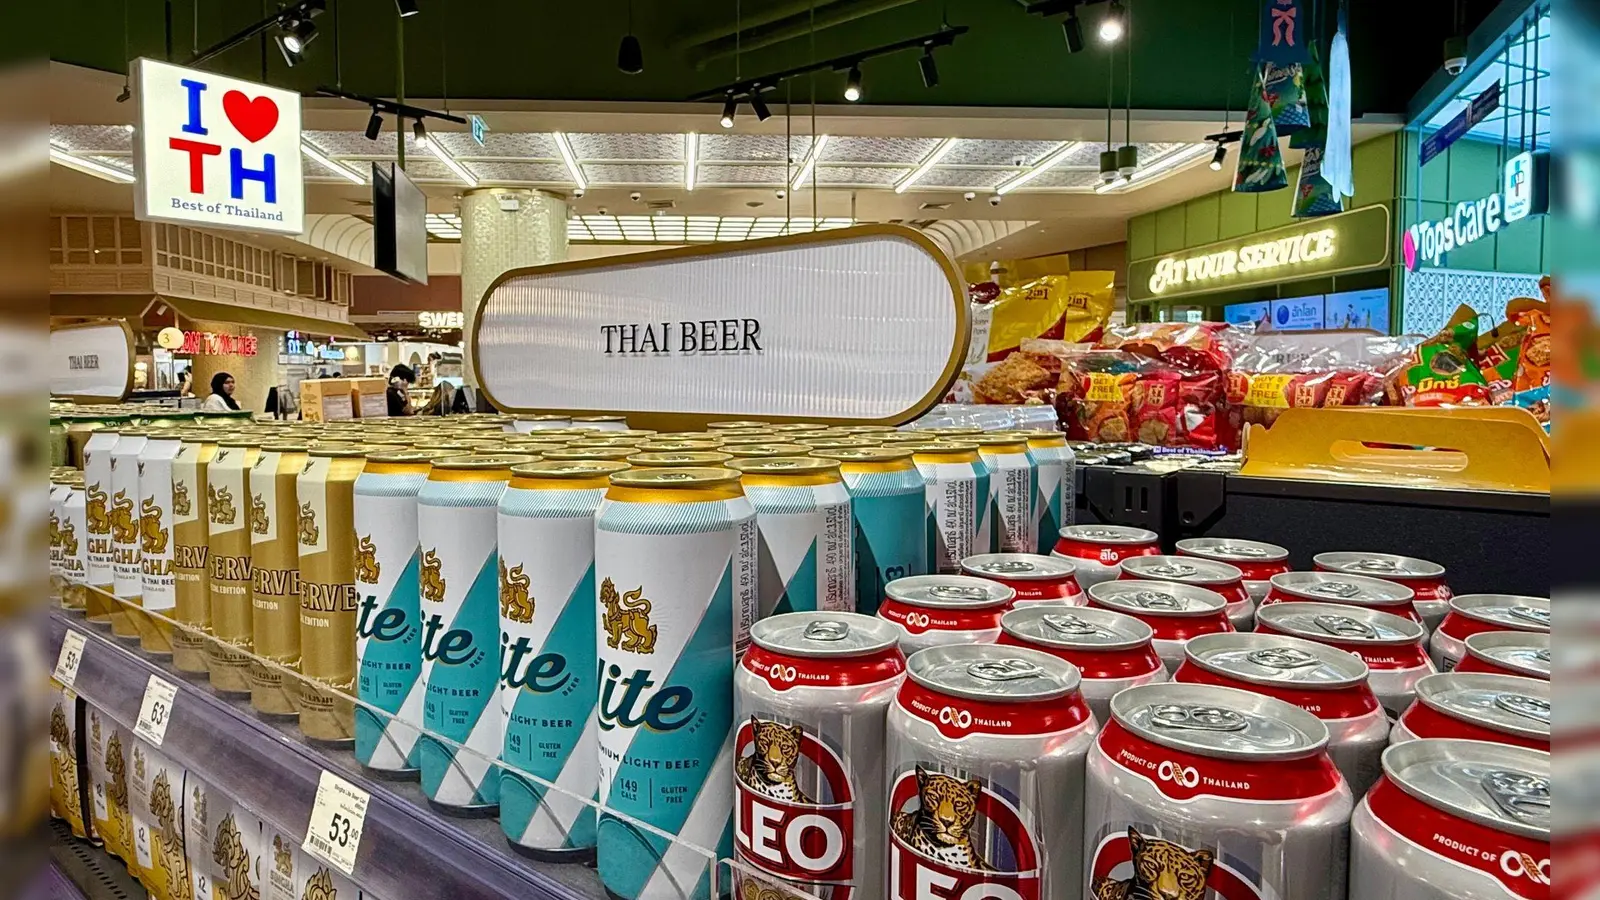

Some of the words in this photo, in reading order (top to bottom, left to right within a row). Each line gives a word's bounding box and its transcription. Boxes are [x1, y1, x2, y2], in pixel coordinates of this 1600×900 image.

[181, 78, 208, 135] I
[169, 137, 277, 204] TH
[171, 198, 203, 214] Best
[206, 202, 222, 215] of
[224, 203, 284, 222] Thailand
[162, 333, 170, 344] 3
[600, 322, 670, 354] THAI
[679, 318, 763, 352] BEER
[68, 355, 82, 370] THAI
[83, 354, 100, 369] BEER
[1251, 390, 1278, 398] FREE
[220, 586, 246, 594] EDITION
[256, 600, 278, 610] EDITION
[304, 616, 329, 627] EDITION
[65, 651, 76, 670] 53
[362, 659, 382, 669] LIGHT
[386, 662, 412, 670] BEER
[798, 672, 830, 680] THAILAND
[426, 684, 448, 696] LIGHT
[452, 688, 480, 696] BEER
[562, 676, 580, 697] BEER
[151, 702, 164, 725] 63
[911, 700, 931, 712] PRODUCT
[931, 708, 939, 716] OF
[510, 714, 538, 728] LIGHT
[542, 719, 572, 728] BEER
[688, 711, 708, 734] BEER
[974, 718, 1012, 728] THAILAND
[508, 733, 522, 746] 149
[538, 742, 561, 750] GLUTEN
[623, 754, 660, 770] LIGHT
[666, 759, 700, 770] BEER
[1120, 749, 1146, 766] PRODUCT
[1146, 762, 1157, 770] OF
[620, 778, 638, 792] 149
[661, 786, 688, 794] GLUTEN
[1202, 776, 1250, 790] THAILAND
[621, 792, 637, 802] CALS
[666, 796, 683, 804] FREE
[736, 785, 844, 871] LEO
[1432, 833, 1480, 856] PRODUCT
[1481, 851, 1498, 862] OF
